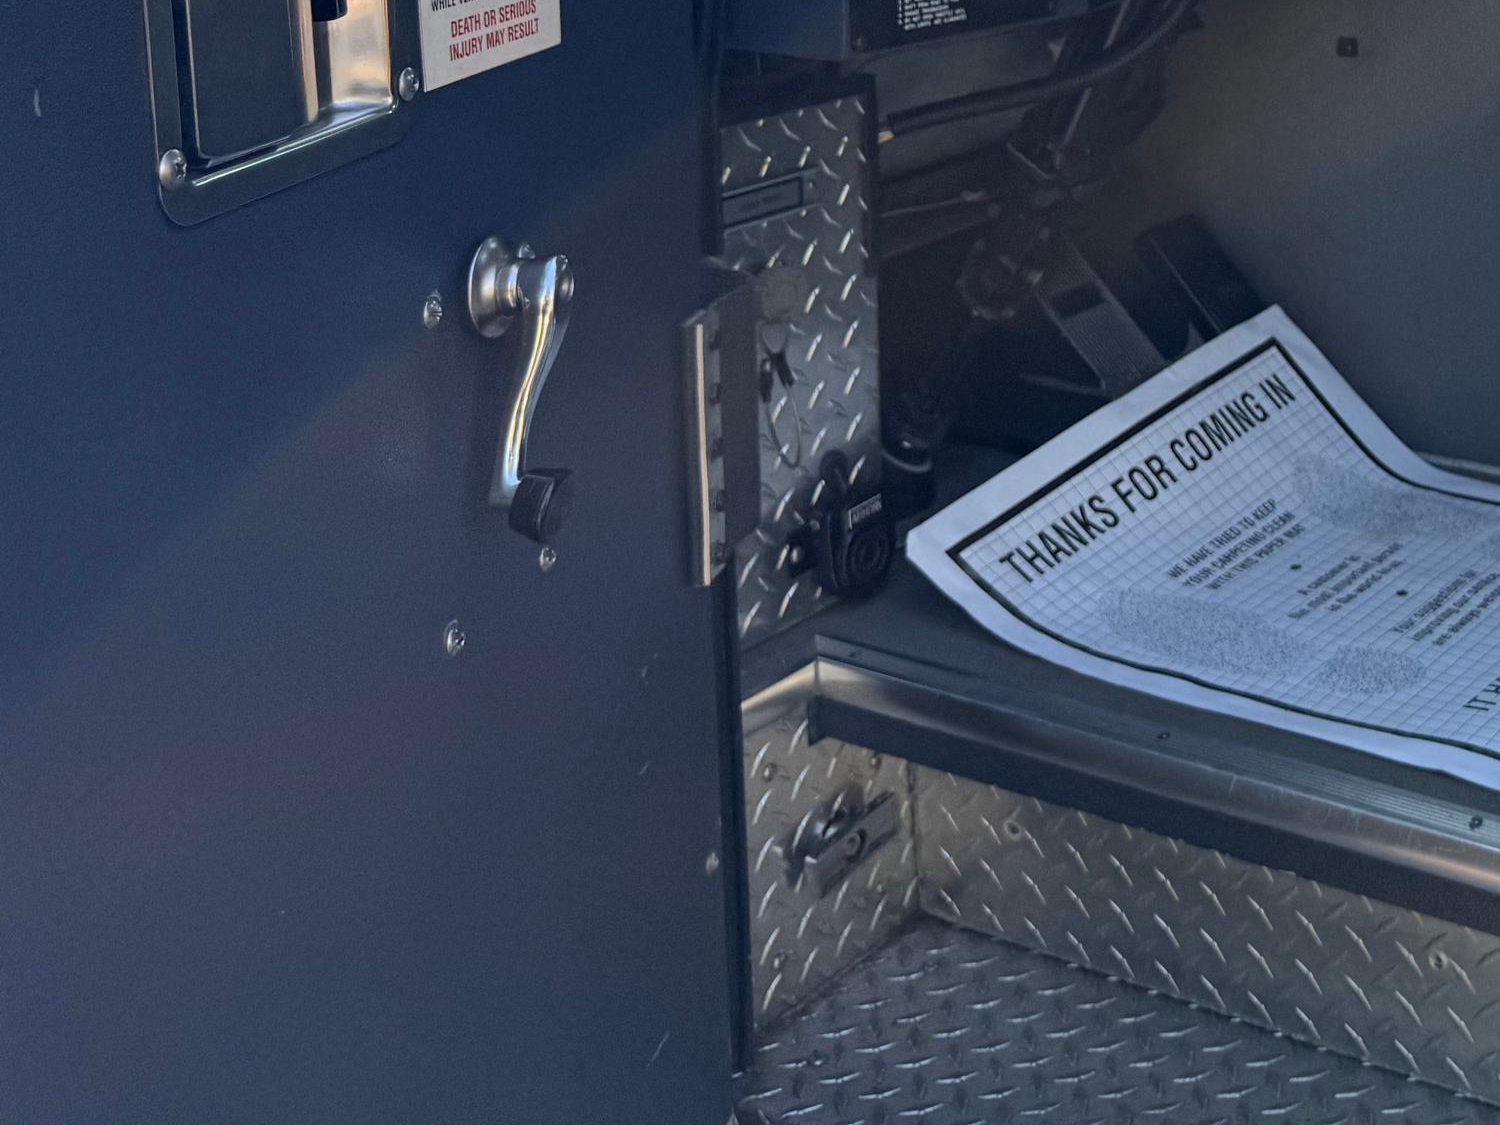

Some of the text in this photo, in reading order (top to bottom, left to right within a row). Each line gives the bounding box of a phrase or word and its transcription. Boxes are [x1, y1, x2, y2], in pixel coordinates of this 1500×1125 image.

[449, 18, 540, 61] INJURY MAY RESULT
[451, 14, 481, 38] DEATH
[483, 9, 497, 28] OR
[999, 374, 1296, 583] THANKS FOR COMING IN
[1168, 498, 1277, 579] WE HAVE TRIED TO KEEP
[1182, 510, 1297, 587] YOUR CARPETING CLEAN
[1463, 695, 1497, 711] IT
